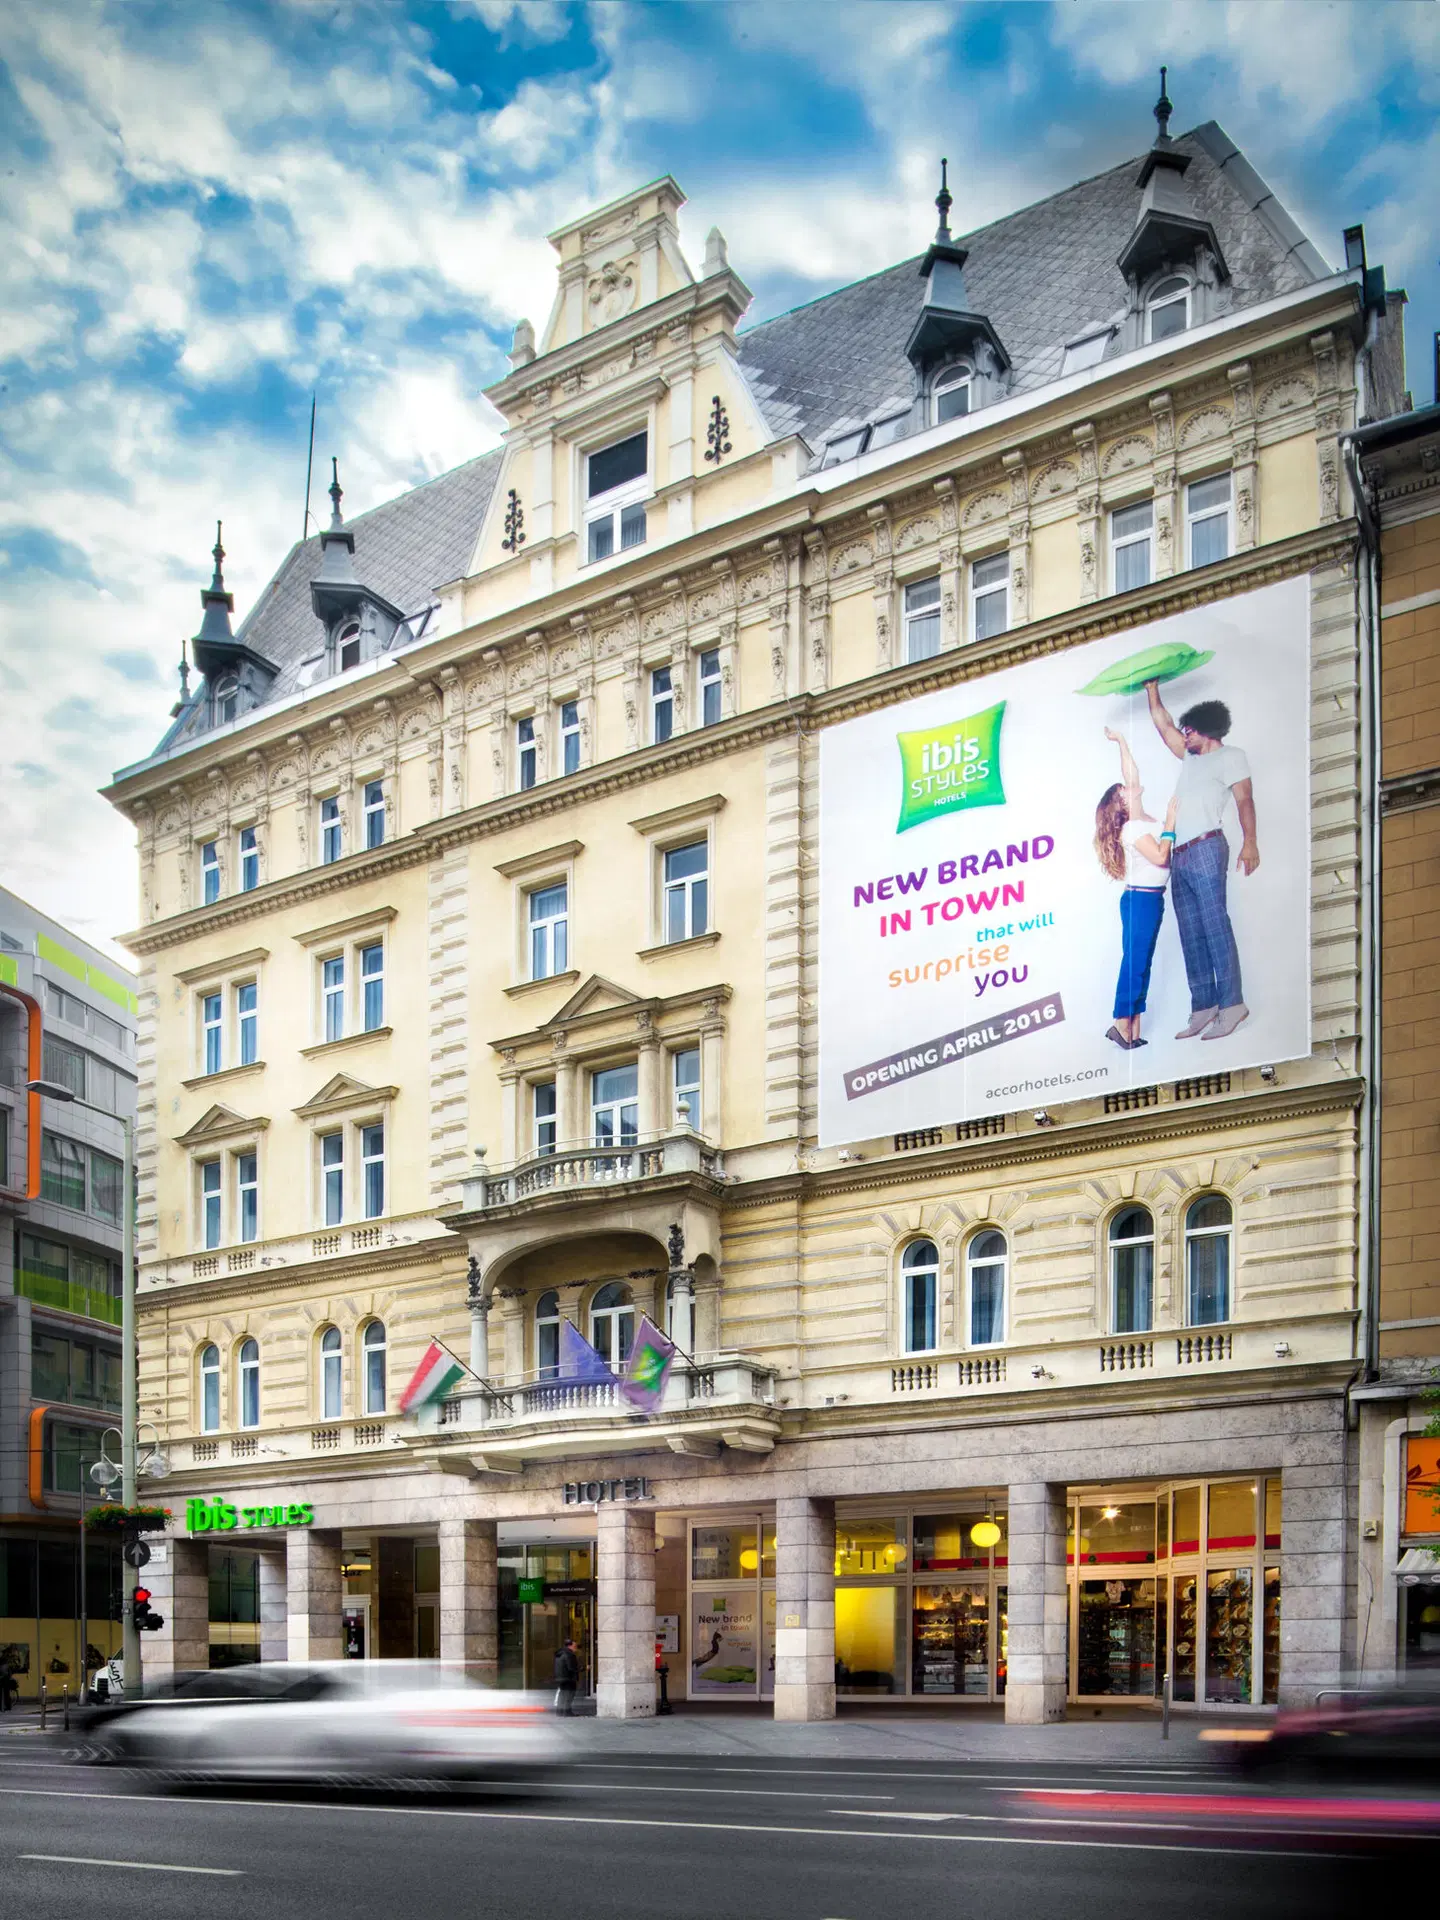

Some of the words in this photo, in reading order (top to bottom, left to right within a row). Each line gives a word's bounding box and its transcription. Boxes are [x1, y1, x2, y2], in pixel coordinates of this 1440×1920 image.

[922, 734, 980, 774] ibis
[933, 791, 967, 806] HOTELS
[853, 866, 929, 908] NEW
[937, 834, 1055, 885] BRAND
[879, 908, 912, 938] IN
[919, 879, 1025, 926] TOWN
[976, 927, 1015, 943] that
[1018, 911, 1055, 932] will
[888, 943, 1011, 988] surprise
[974, 964, 1029, 998] you
[851, 1048, 939, 1093] OPENING
[941, 1026, 1002, 1060] APRIL
[1004, 1003, 1057, 1036] 2016
[985, 1066, 1109, 1099] accorhotels.com
[562, 1476, 655, 1504] HOTEL
[186, 1495, 238, 1531] ibis
[520, 1581, 535, 1591] ibis
[698, 1614, 721, 1624] New
[722, 1613, 753, 1624] brand
[721, 1623, 731, 1632] in
